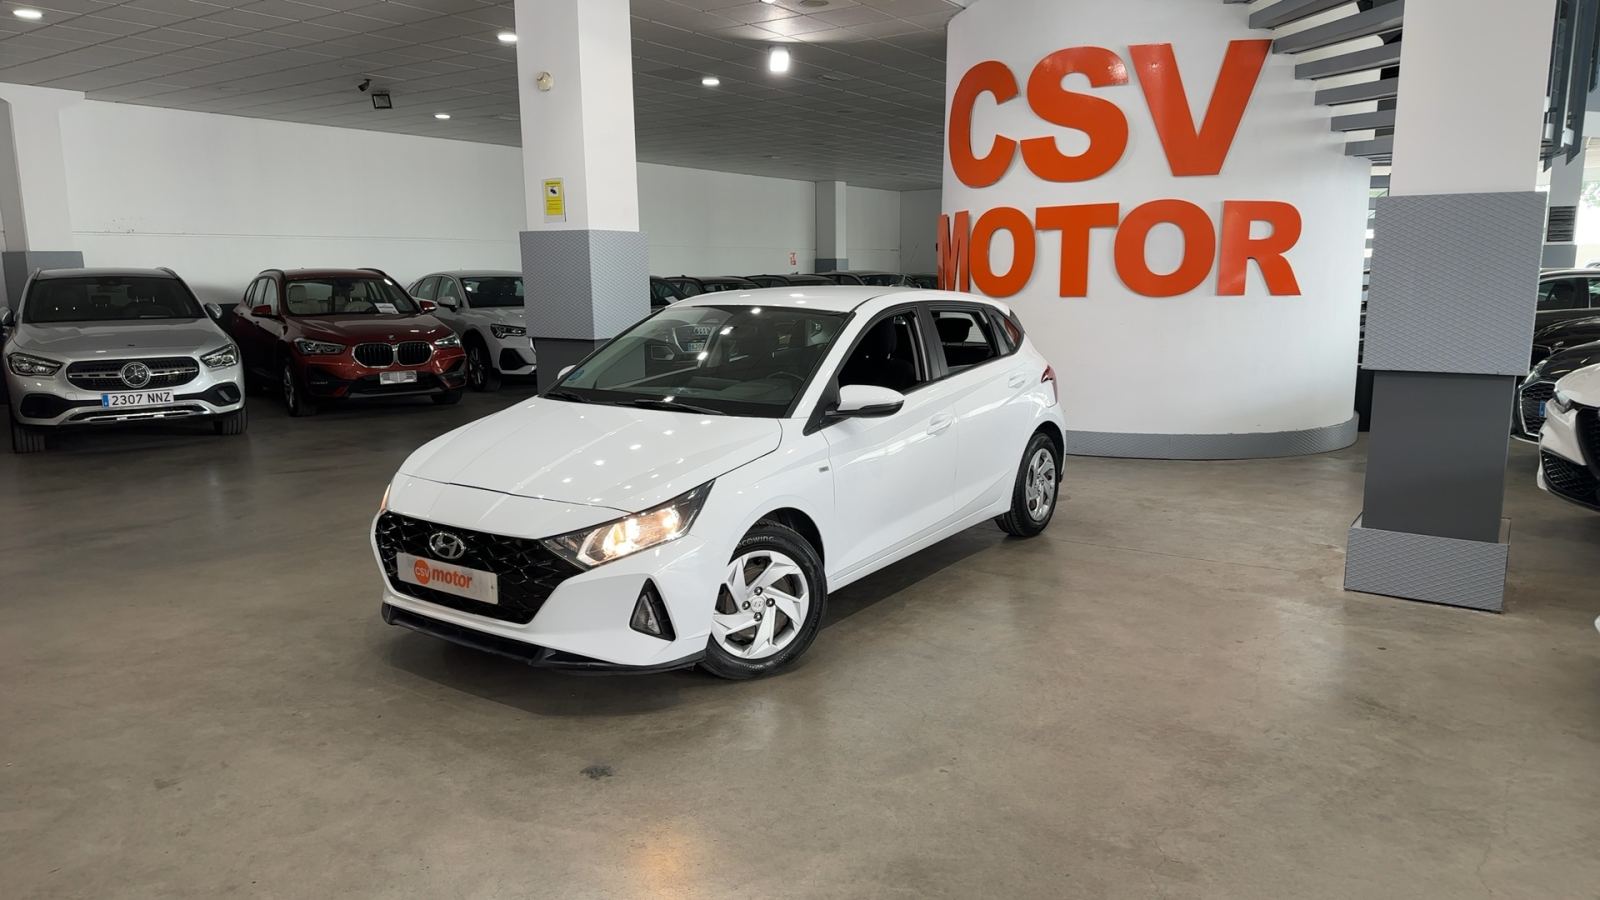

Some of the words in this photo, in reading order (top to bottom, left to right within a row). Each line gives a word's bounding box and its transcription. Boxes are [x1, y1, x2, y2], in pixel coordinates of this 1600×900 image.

[949, 39, 1273, 189] CSV
[936, 199, 1302, 298] MOTOR
[112, 394, 143, 406] 2307
[147, 392, 170, 403] NNZ
[432, 568, 473, 589] motor
